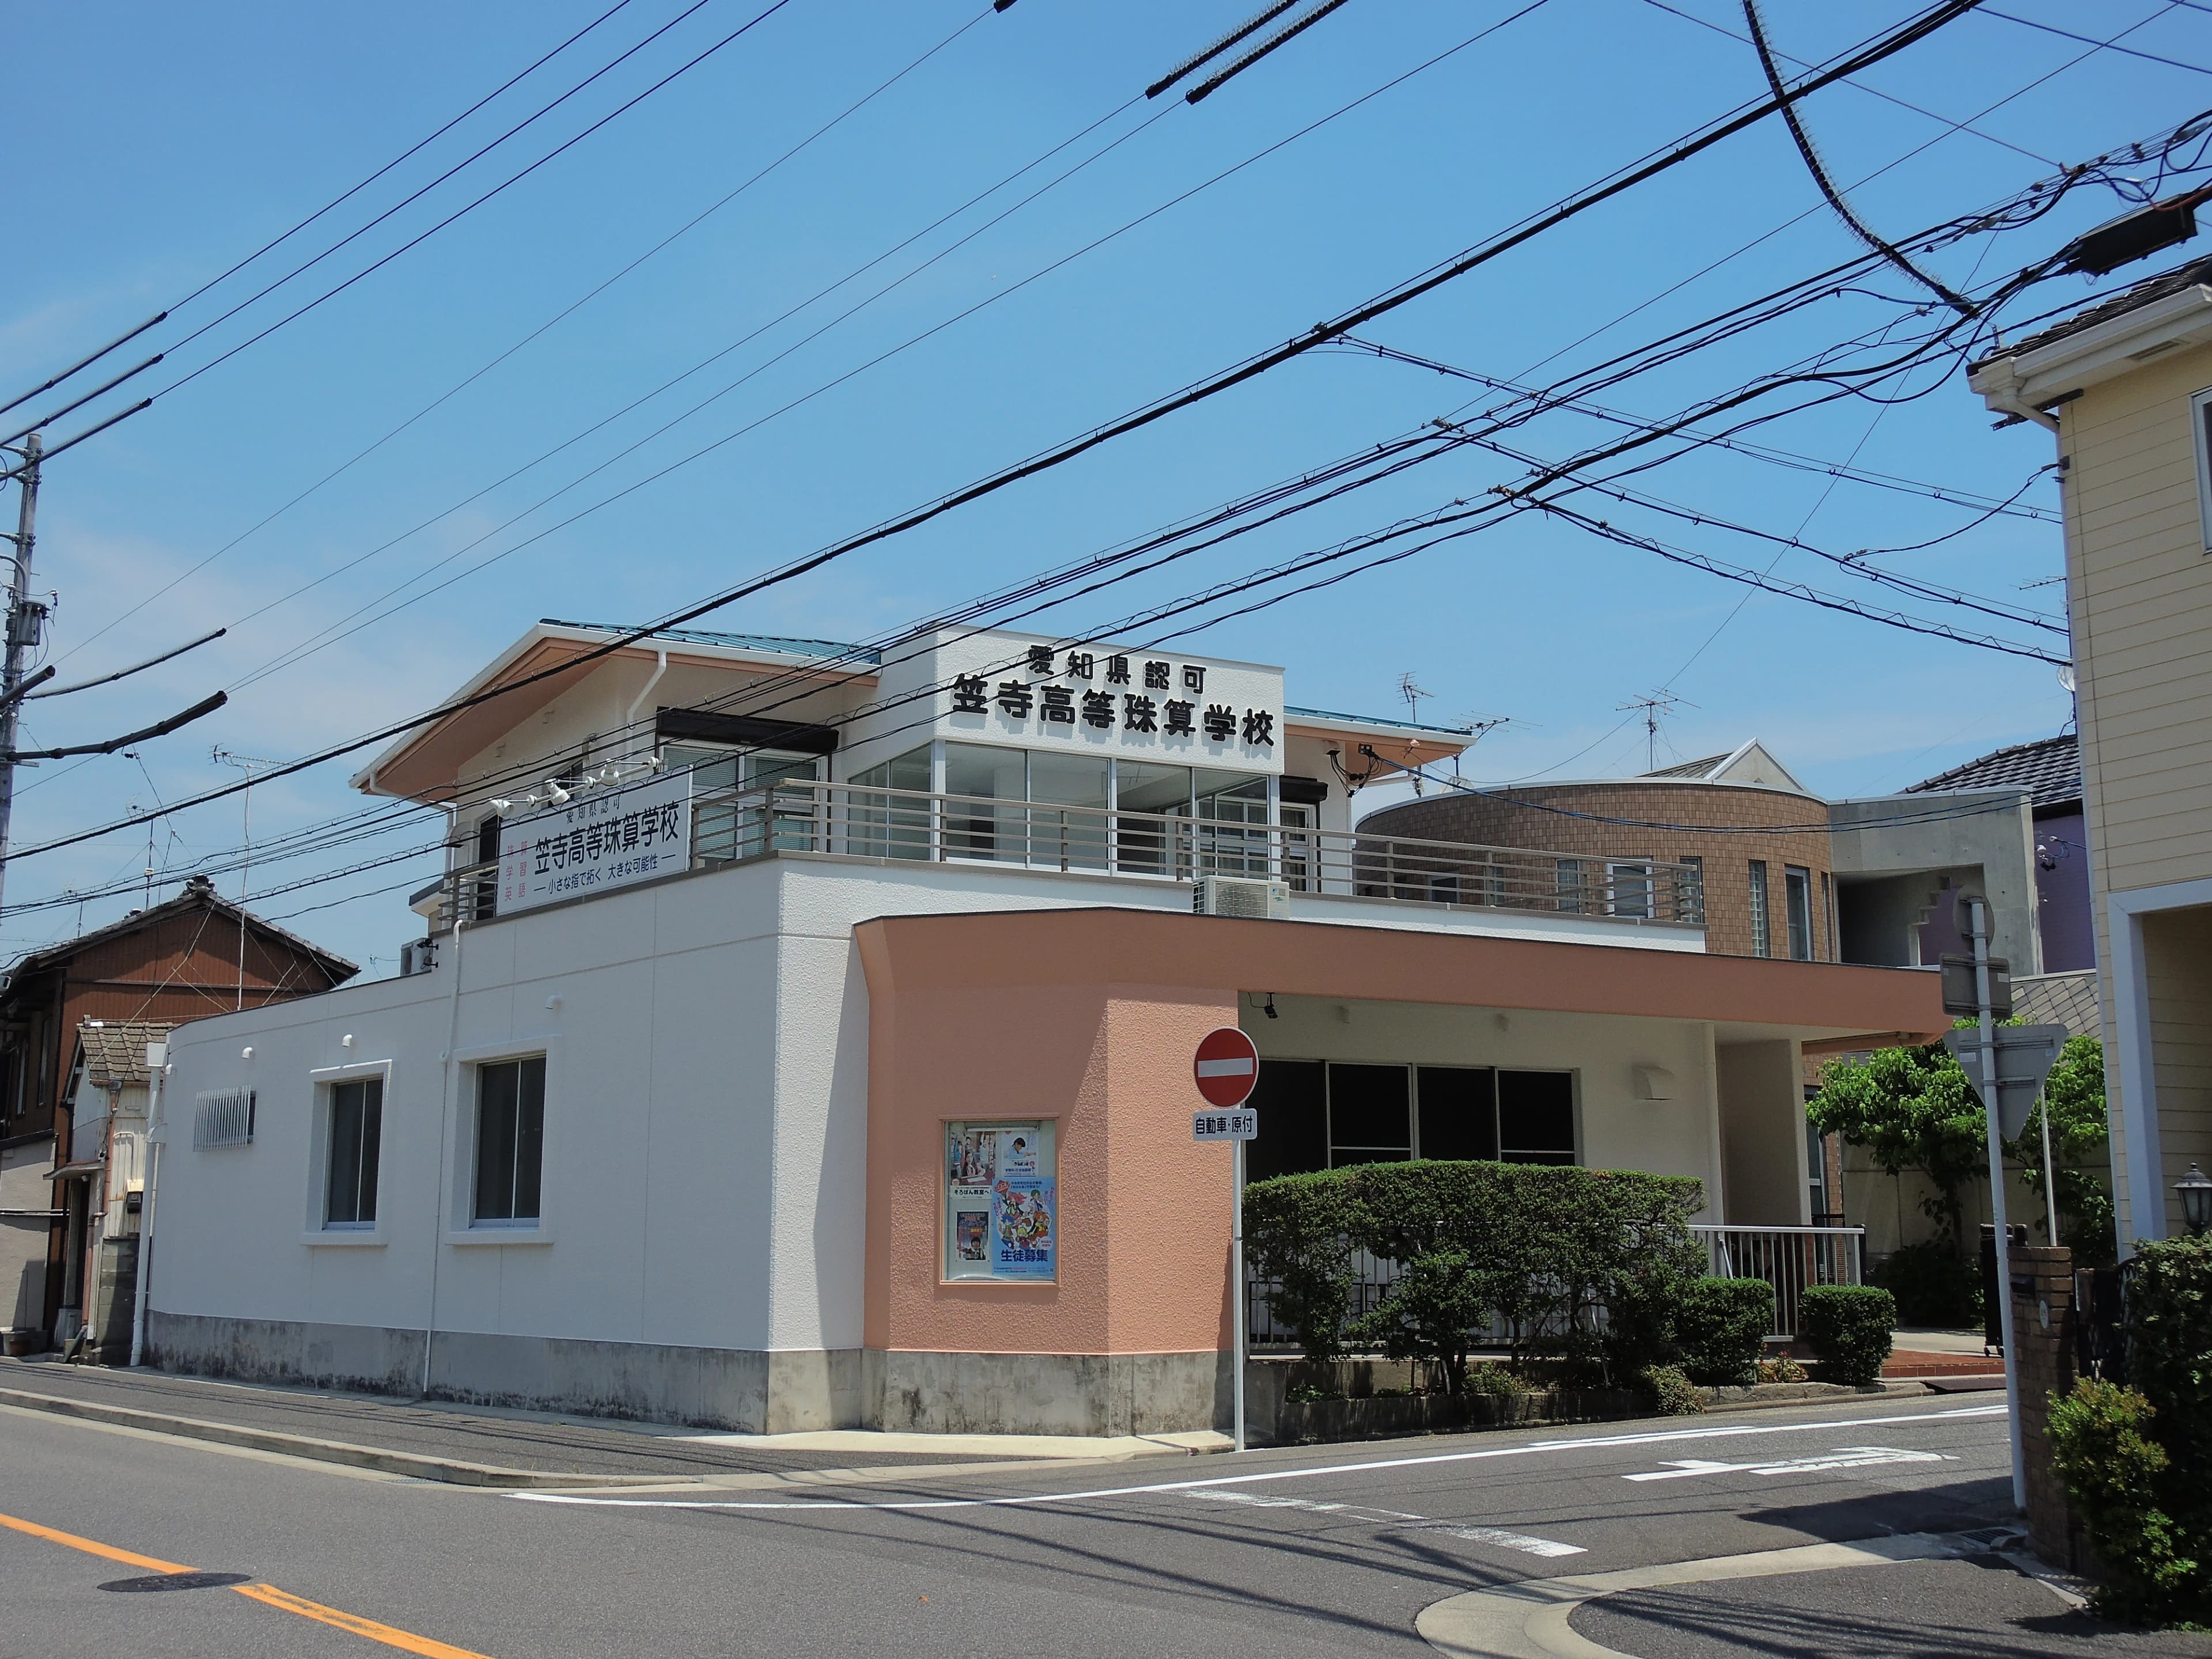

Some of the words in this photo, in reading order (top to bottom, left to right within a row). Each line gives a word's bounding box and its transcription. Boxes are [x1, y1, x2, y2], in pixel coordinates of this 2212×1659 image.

[1027, 643, 1207, 694] 愛知県認可
[951, 672, 1275, 747] 笠寺高等珠算学校
[534, 800, 679, 875] 笠寺高等珠算学校
[1195, 1115, 1253, 1134] 自動車・原付
[1001, 1249, 1048, 1262] 生徒募集
